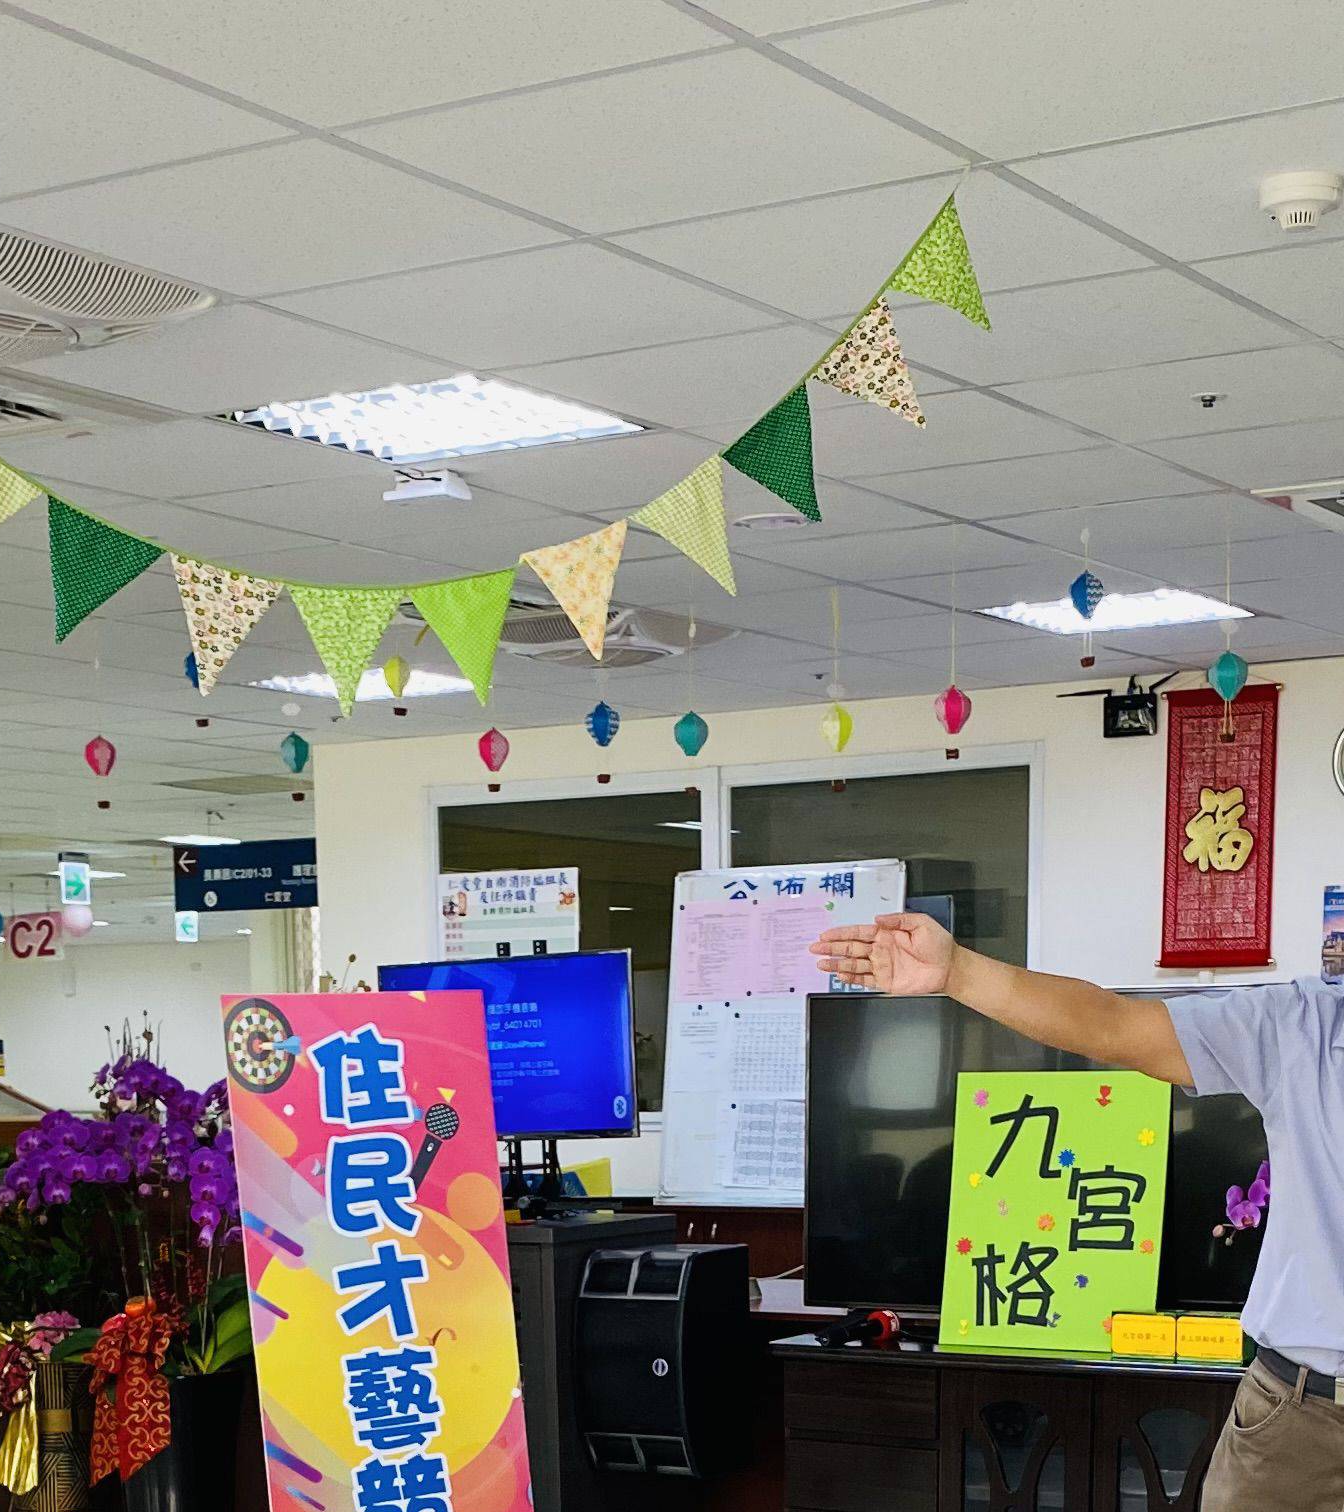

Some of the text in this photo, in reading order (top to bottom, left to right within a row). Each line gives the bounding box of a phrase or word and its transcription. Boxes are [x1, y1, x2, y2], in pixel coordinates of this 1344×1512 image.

[1182, 785, 1254, 873] 福
[723, 871, 855, 900] 公佈欄
[10, 918, 56, 960] C2
[971, 1093, 1147, 1328] 九宮格
